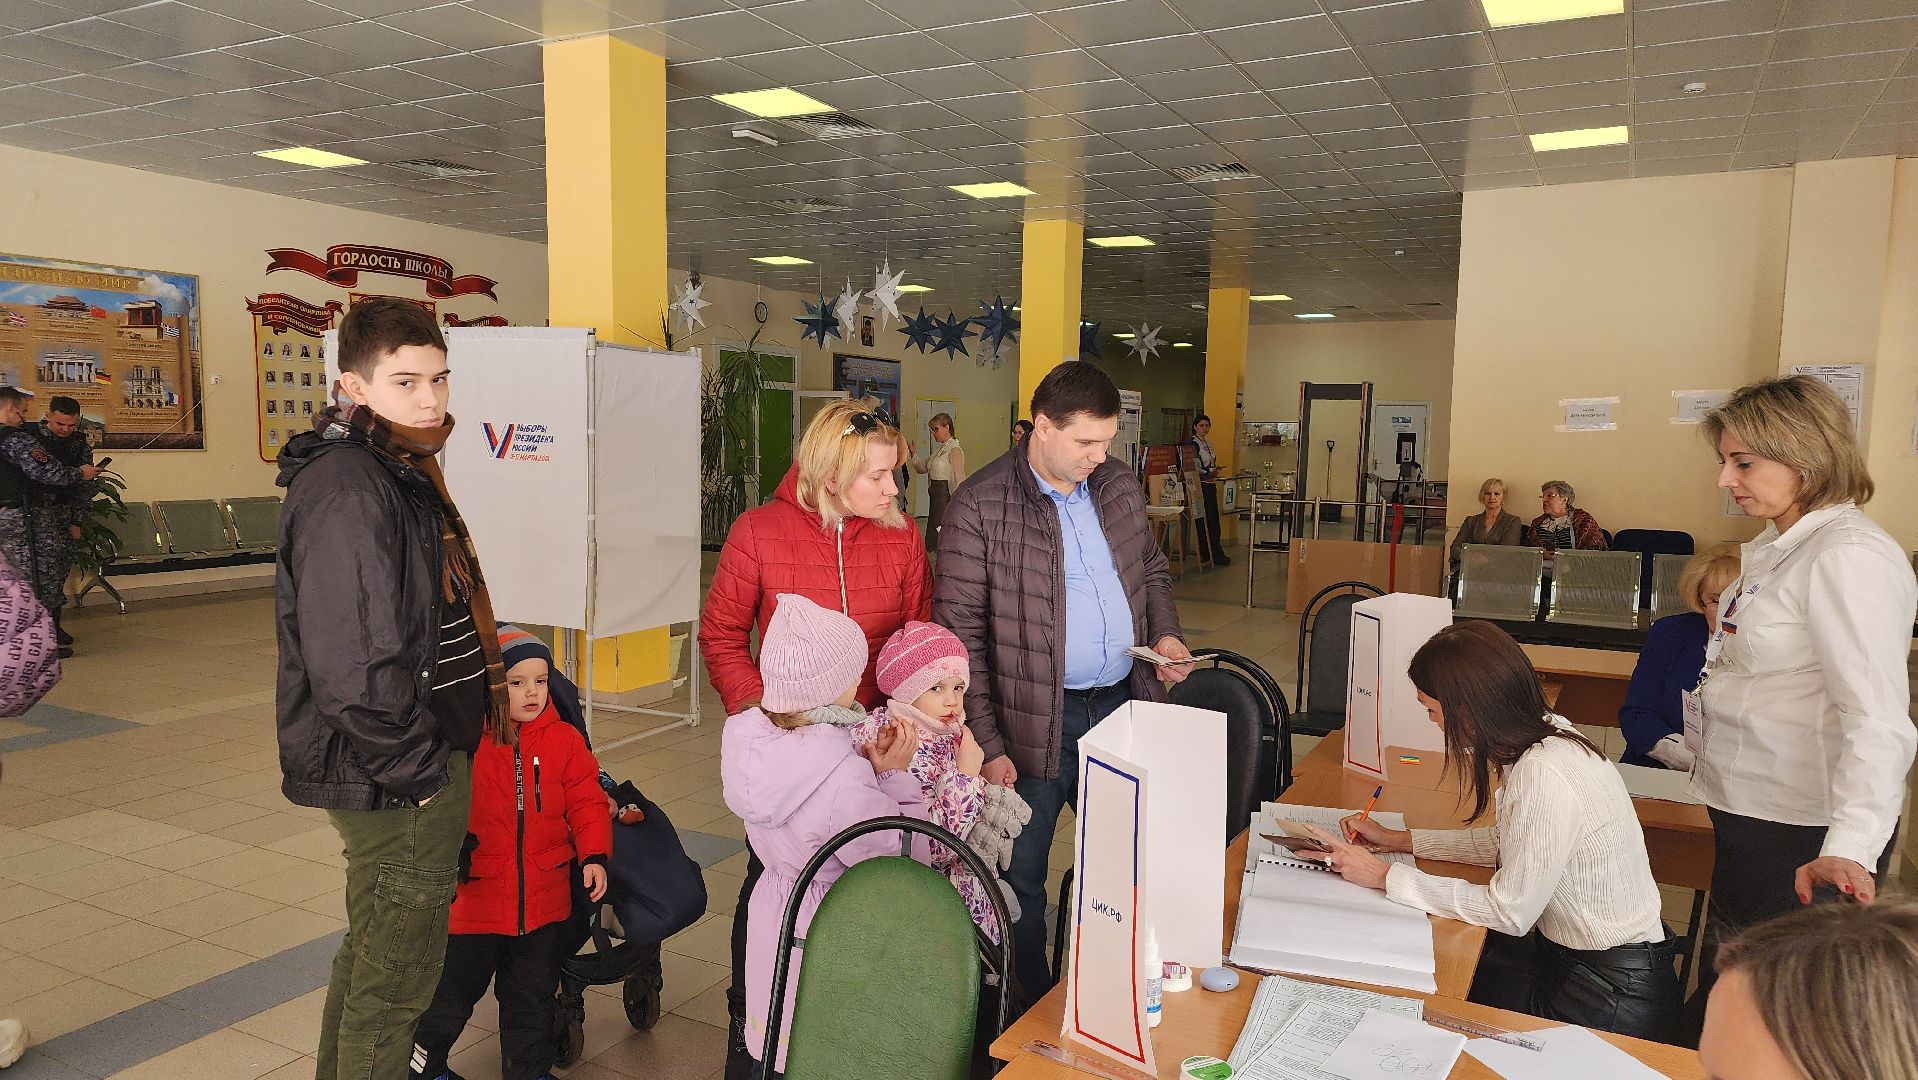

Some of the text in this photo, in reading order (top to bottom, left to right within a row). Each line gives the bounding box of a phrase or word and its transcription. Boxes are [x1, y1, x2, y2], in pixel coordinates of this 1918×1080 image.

[332, 251, 449, 280] ГОРДОСТЬ ШКОЛЫ
[96, 276, 132, 290] МИР
[514, 434, 555, 444] ПРЕЗИДЕНТА
[516, 423, 548, 433] ВЫБОРЫ
[8, 636, 24, 661] GAP
[28, 632, 43, 657] GAP
[1091, 897, 1123, 924] ЦИК.РФ
